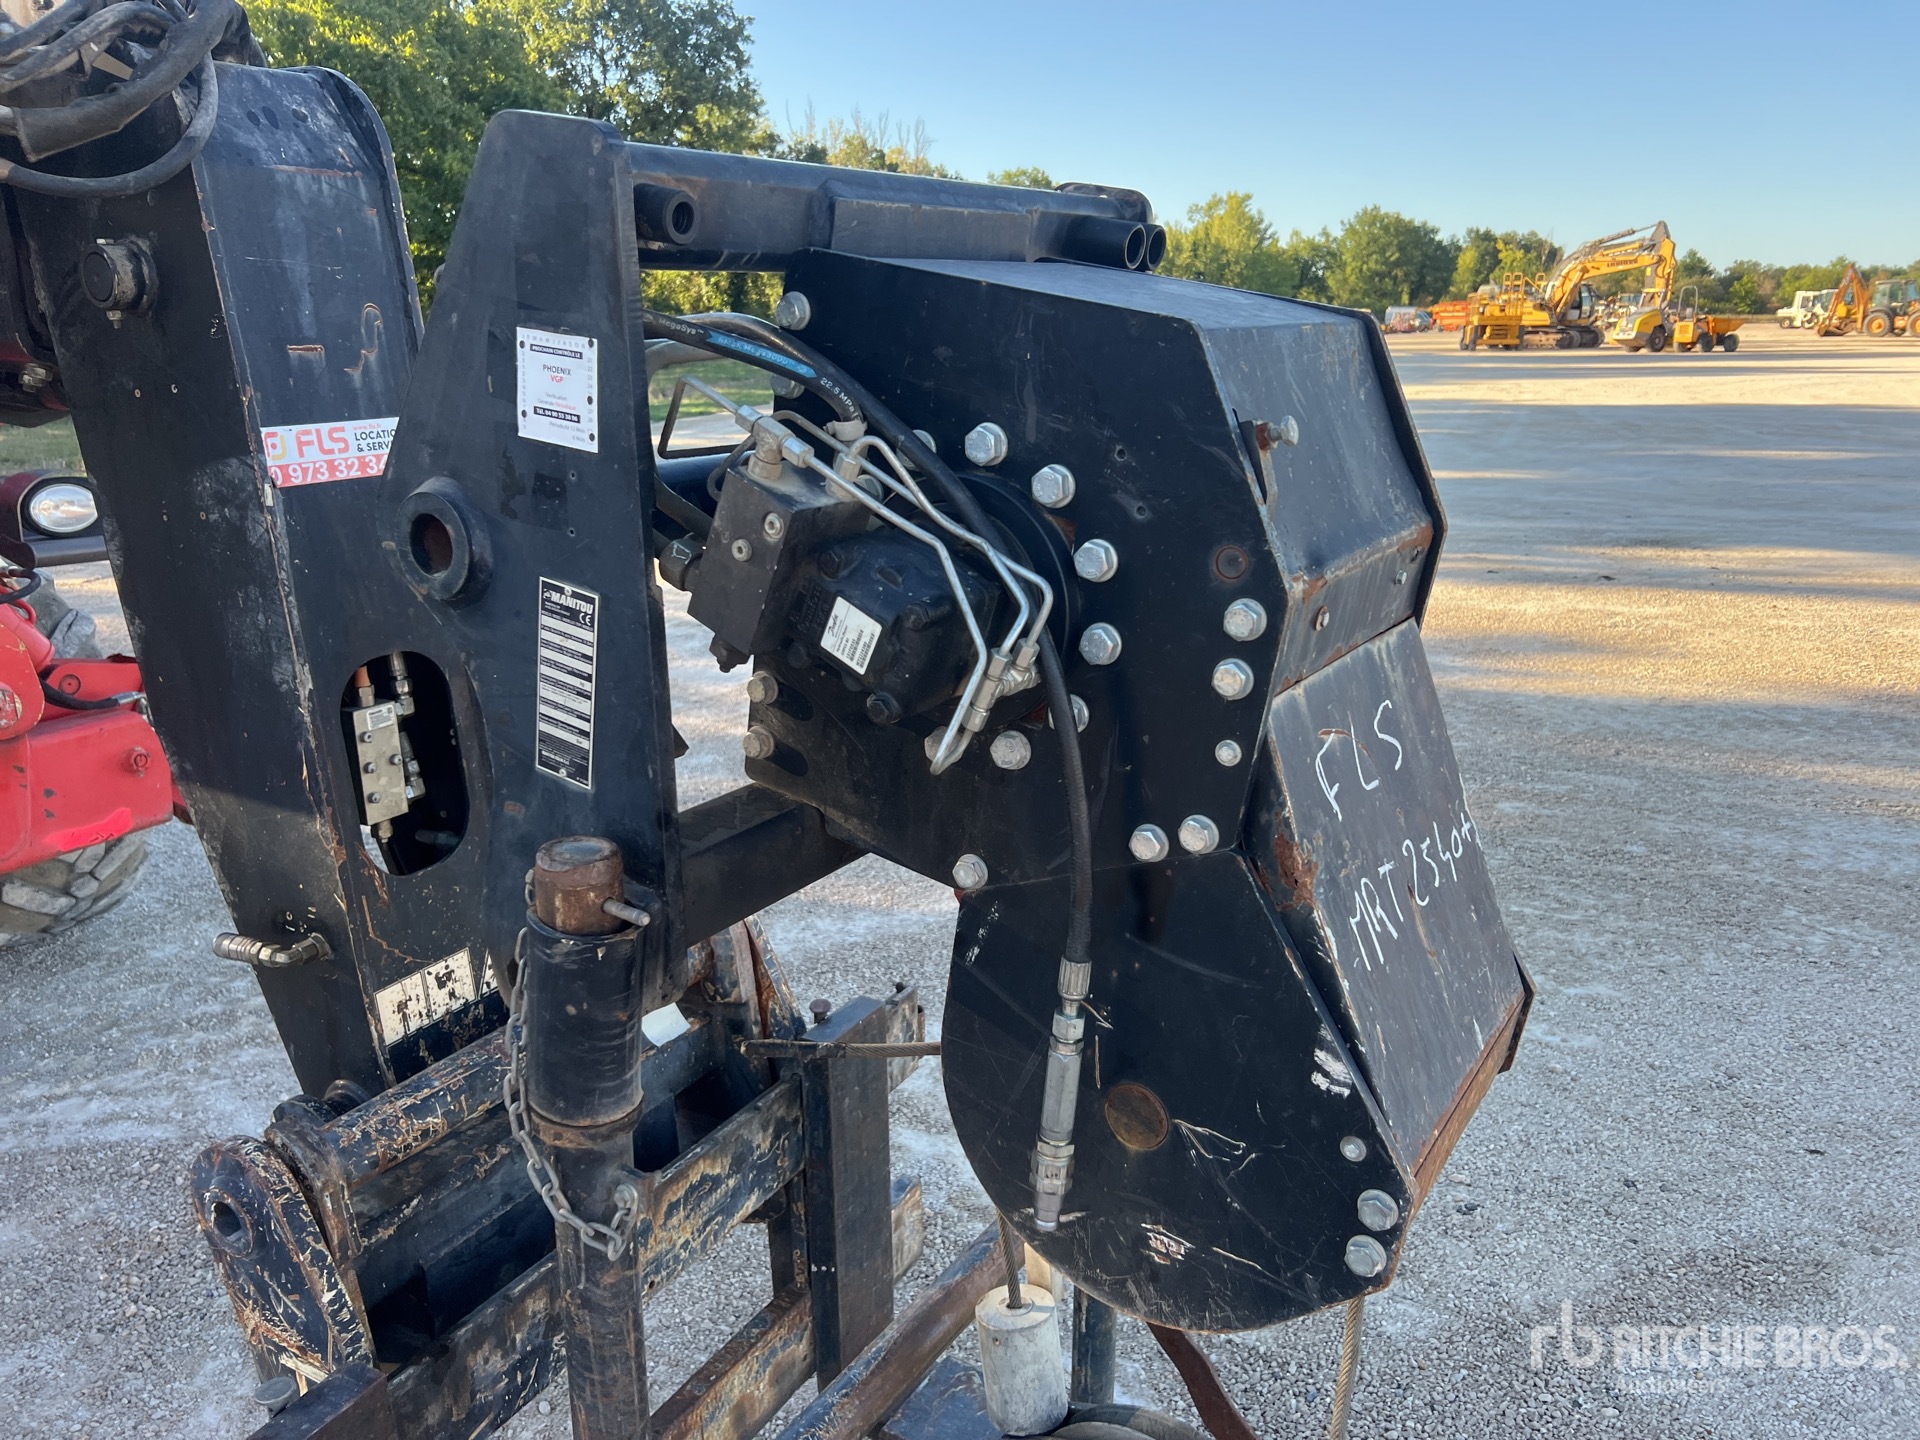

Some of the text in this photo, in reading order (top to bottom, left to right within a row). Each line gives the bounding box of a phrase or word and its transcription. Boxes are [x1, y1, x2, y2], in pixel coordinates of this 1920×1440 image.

[542, 364, 572, 376] PHOENIX
[550, 375, 564, 384] VGP
[820, 377, 855, 413] 22.5 MPa
[295, 425, 350, 458] FLS
[354, 428, 396, 441] LOCATIO
[357, 440, 392, 452] & SERV
[288, 461, 329, 484] 973
[334, 458, 361, 478] 32
[551, 592, 594, 614] MANITOU
[579, 612, 592, 626] CE
[1315, 699, 1403, 822] FLS
